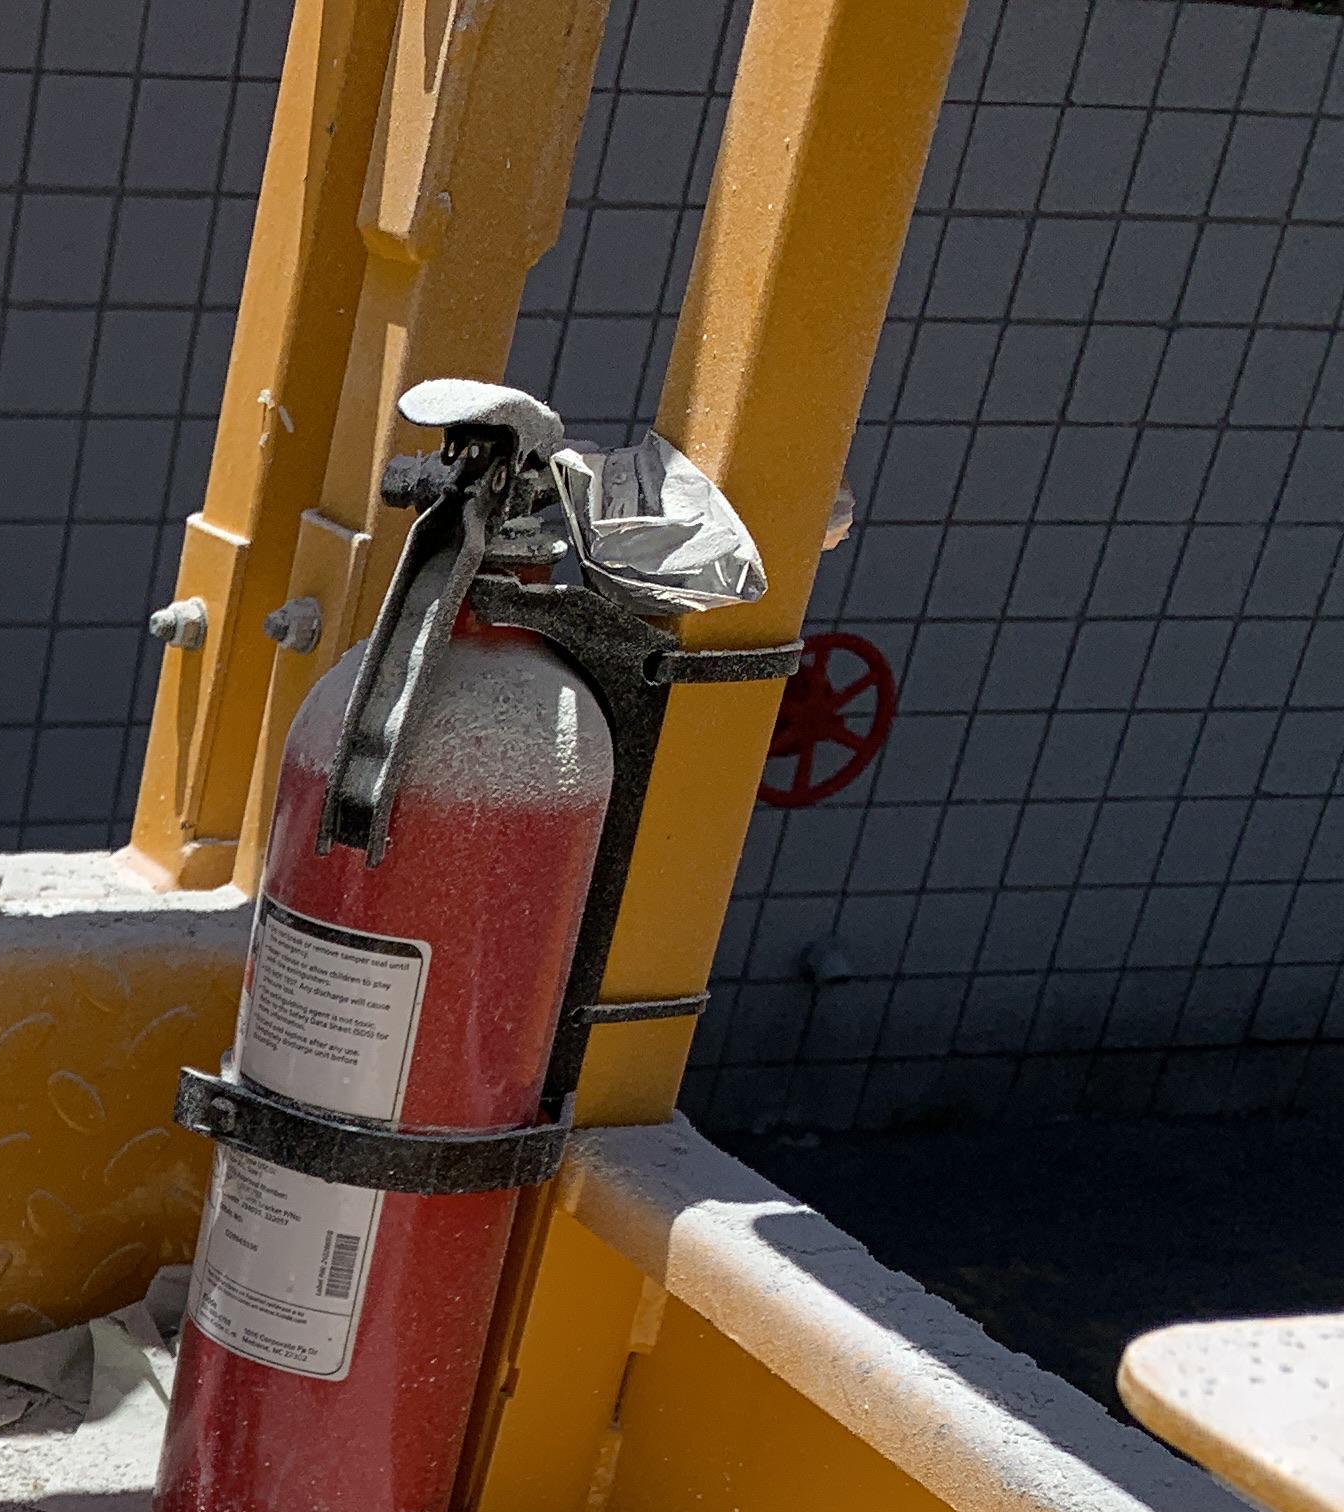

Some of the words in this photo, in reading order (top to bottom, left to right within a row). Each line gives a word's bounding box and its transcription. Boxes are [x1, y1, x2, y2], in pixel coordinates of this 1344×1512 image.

[312, 944, 338, 957] remove
[340, 952, 369, 965] tamper
[370, 959, 387, 967] seal
[388, 962, 409, 970] until
[309, 964, 327, 975] allow
[329, 969, 360, 984] children
[372, 981, 391, 990] play
[298, 982, 313, 993] Any
[313, 987, 348, 1003] discharge
[350, 997, 365, 1005] will
[366, 1001, 390, 1010] cause
[289, 1009, 308, 1022] Safety
[310, 1017, 327, 1027] Data
[328, 1022, 350, 1033] Sheet
[352, 1028, 374, 1038] (SDS)
[308, 1008, 329, 1020] agent
[339, 1016, 352, 1024] not
[309, 1038, 328, 1049] after
[328, 1044, 341, 1053] any
[314, 1049, 329, 1058] unit
[330, 1053, 357, 1065] before
[259, 1333, 295, 1352] Corporate
